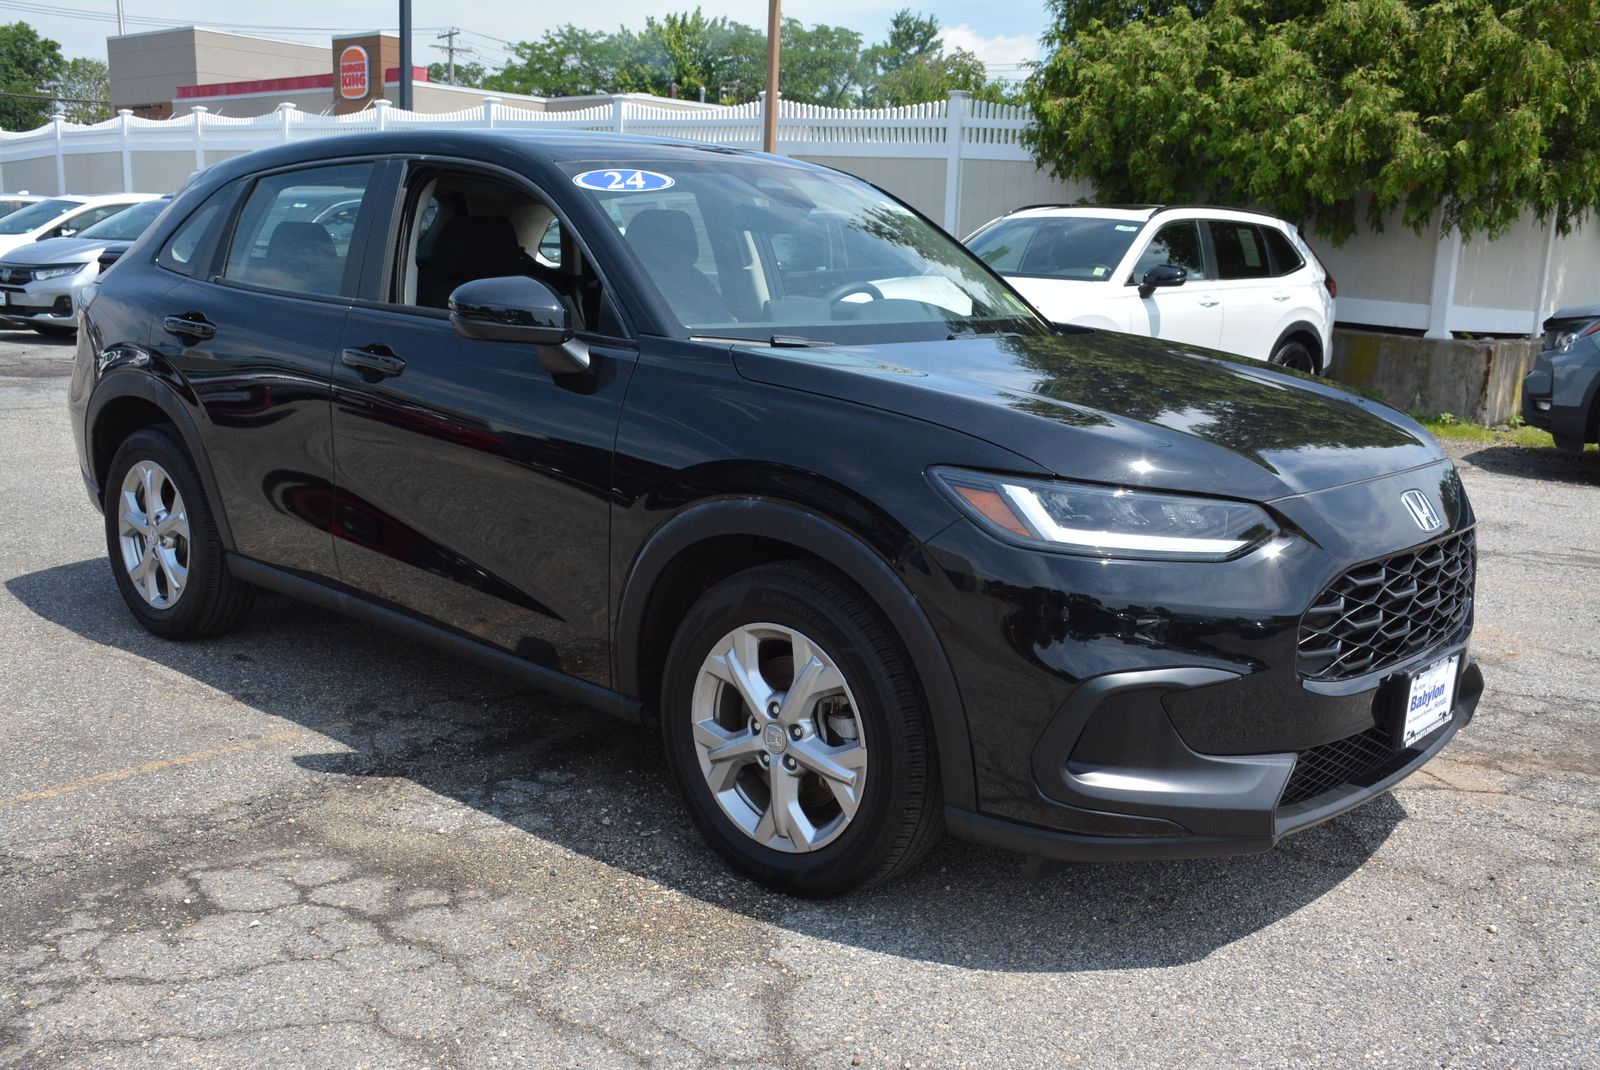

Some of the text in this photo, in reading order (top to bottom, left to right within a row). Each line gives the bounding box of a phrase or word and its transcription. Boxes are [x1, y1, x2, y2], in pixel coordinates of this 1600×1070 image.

[341, 63, 366, 74] BURGER
[341, 72, 366, 88] KING
[603, 171, 646, 189] 24
[1410, 683, 1446, 712] Babylon
